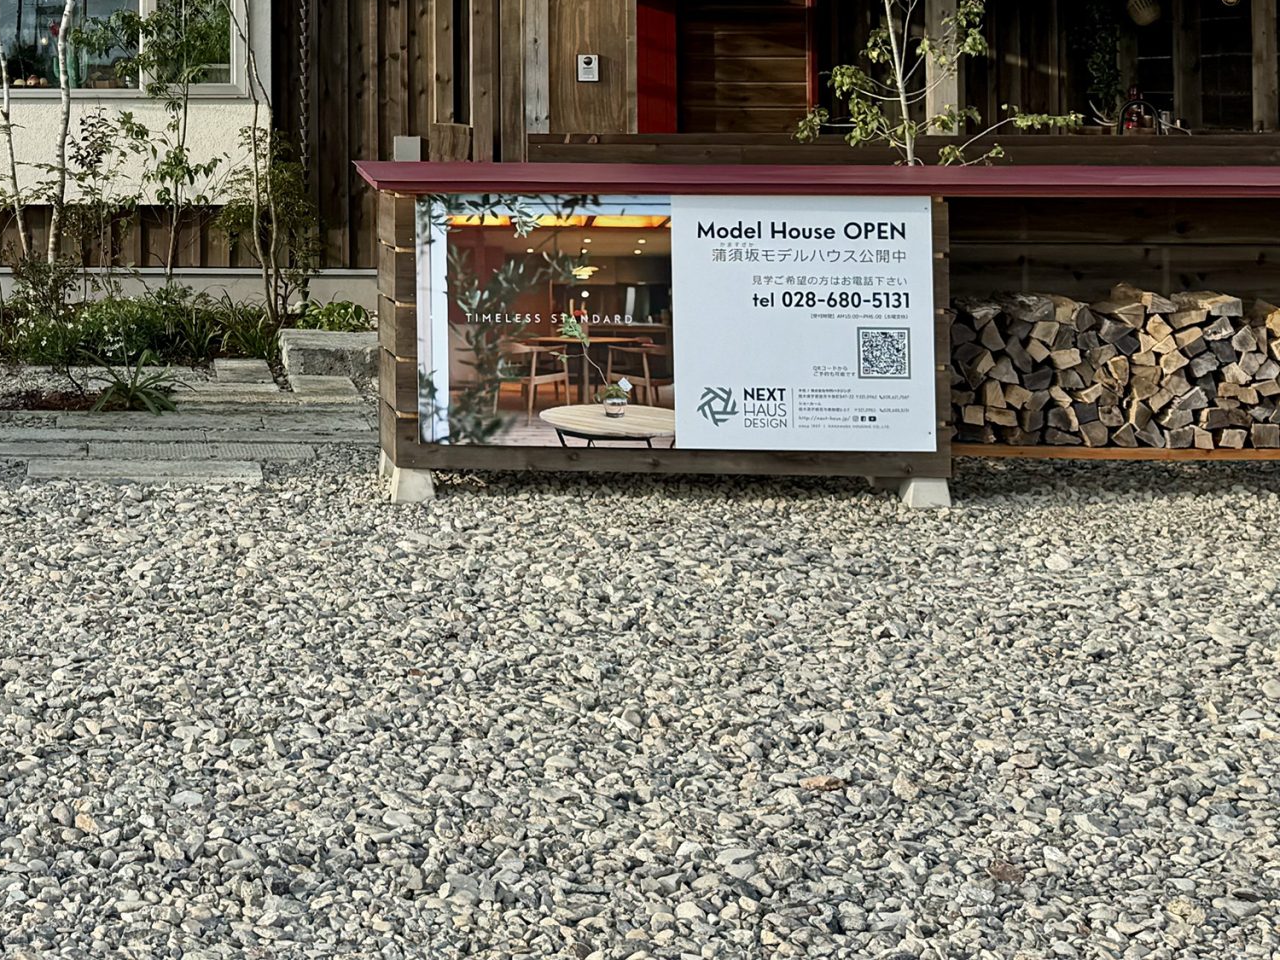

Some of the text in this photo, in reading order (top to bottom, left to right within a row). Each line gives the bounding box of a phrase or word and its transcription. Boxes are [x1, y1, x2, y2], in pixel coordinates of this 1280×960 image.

[697, 221, 906, 240] Model House OPEN
[712, 248, 906, 263] 蒲須坂モデルハウス公開中
[752, 275, 907, 286] 見学ご希望の方はお電話下さい
[752, 291, 910, 308] tel 028-680-5131
[465, 313, 633, 324] TIMELESS STANDARD
[744, 387, 786, 401] NEXT
[744, 403, 787, 417] HAUS
[744, 418, 788, 428] DESIGN
